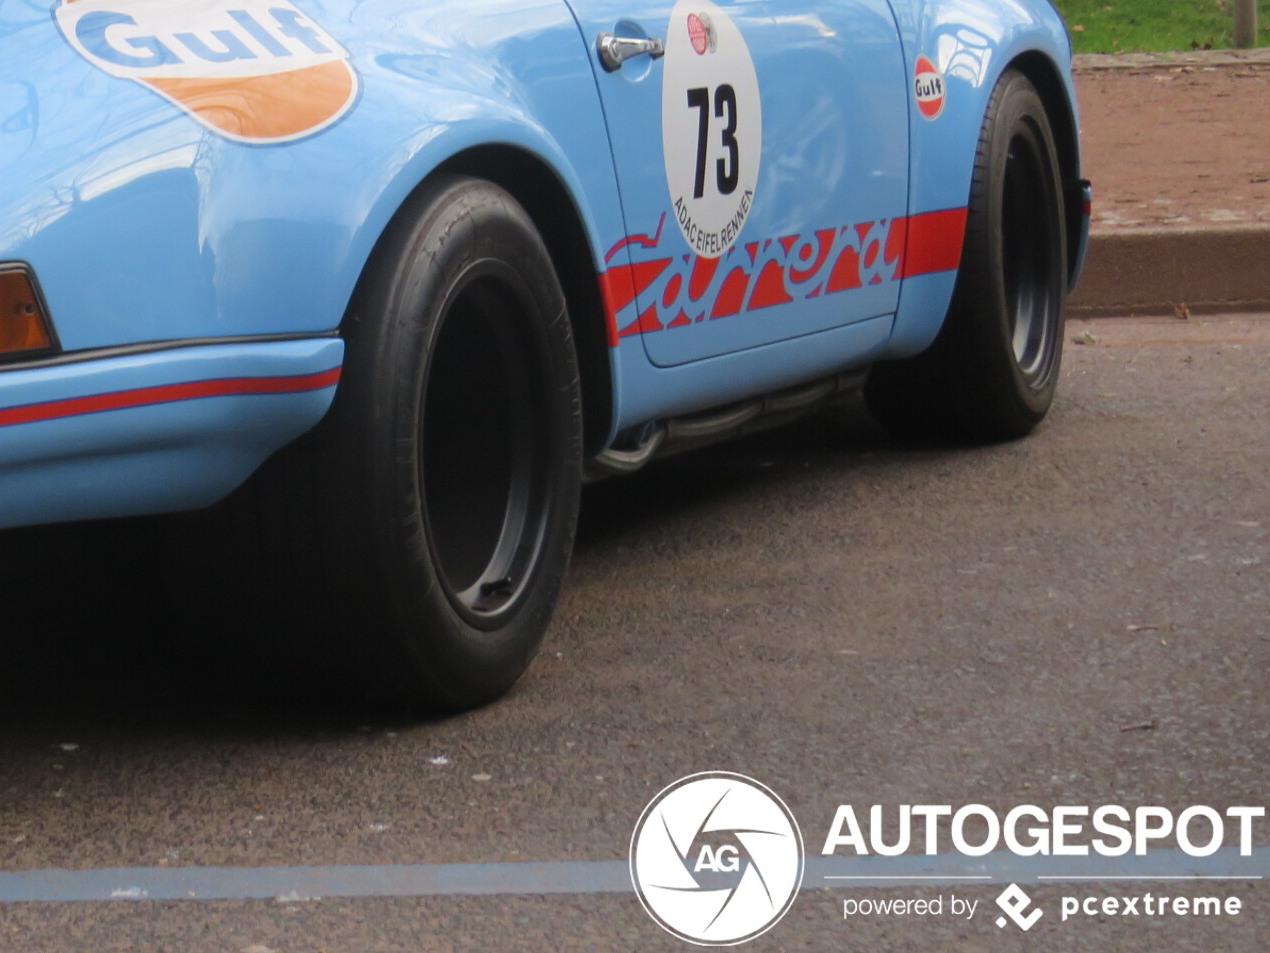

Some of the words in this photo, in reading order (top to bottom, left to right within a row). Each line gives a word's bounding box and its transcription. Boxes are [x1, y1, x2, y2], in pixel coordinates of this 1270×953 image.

[75, 6, 332, 68] Gulf
[915, 77, 941, 97] Gulf
[687, 84, 739, 199] 73
[675, 196, 697, 245] ADAC
